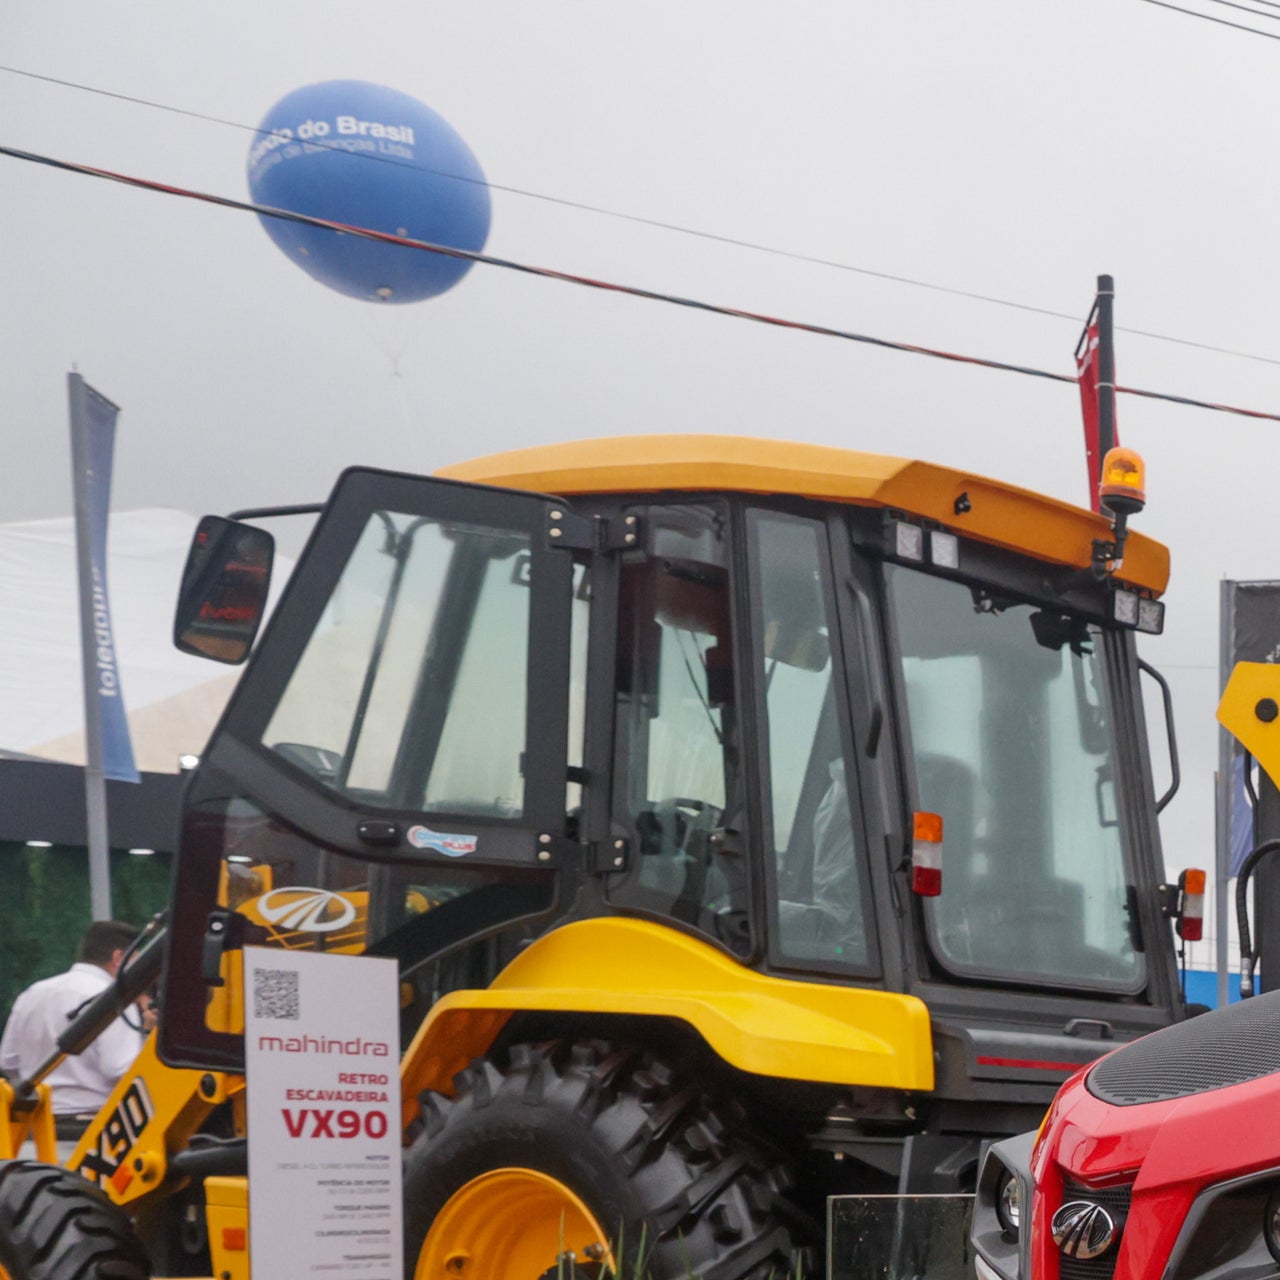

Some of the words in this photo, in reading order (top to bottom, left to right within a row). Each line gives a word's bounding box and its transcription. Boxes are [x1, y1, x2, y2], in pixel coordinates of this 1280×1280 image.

[298, 119, 330, 139] do
[335, 115, 415, 145] Brasil
[258, 1034, 389, 1057] mahindra
[338, 1073, 389, 1085] RETRO
[286, 1089, 389, 1102] ESCAVADEIRA
[78, 1079, 154, 1188] X90
[281, 1108, 388, 1139] VX90
